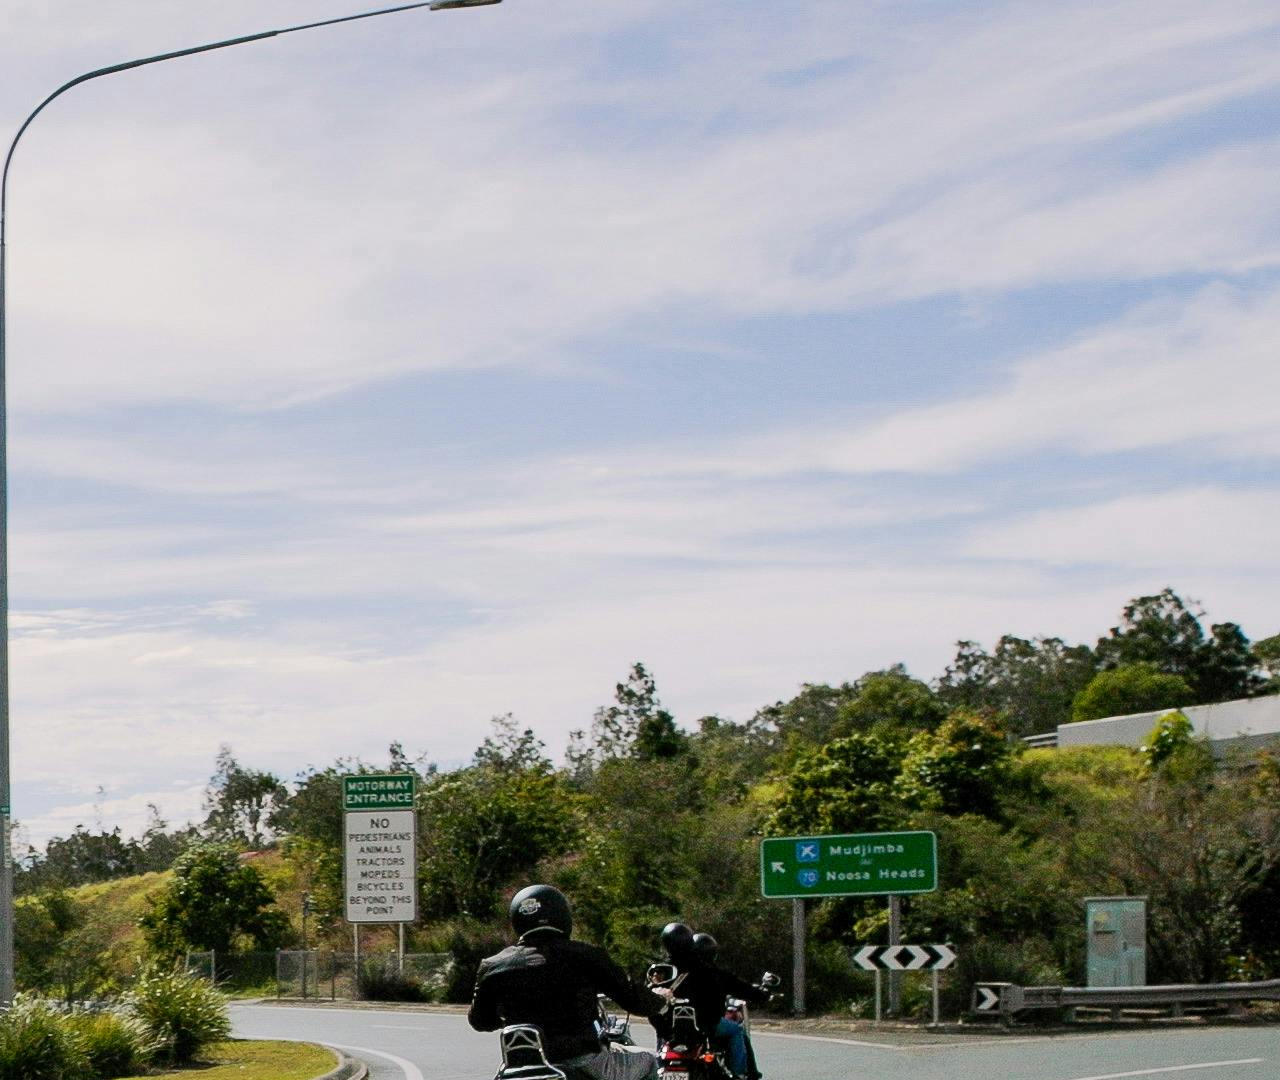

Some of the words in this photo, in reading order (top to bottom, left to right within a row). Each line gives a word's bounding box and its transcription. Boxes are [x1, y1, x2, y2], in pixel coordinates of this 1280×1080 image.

[347, 780, 410, 792] MOTORWAY
[346, 793, 412, 804] ENTRANCE
[370, 818, 390, 829] NO
[349, 833, 412, 842] PEDESTRIANS
[359, 845, 401, 854] ANIMALS
[829, 843, 904, 857] Mudjimba
[356, 857, 405, 867] TRACTORS
[360, 870, 400, 879] MOPEDS
[826, 871, 871, 881] Noosa
[878, 868, 926, 879] Heads
[356, 882, 405, 891] BICYCLES
[349, 896, 387, 905] BEYOND
[391, 895, 412, 904] THIS
[366, 906, 394, 915] POINT
